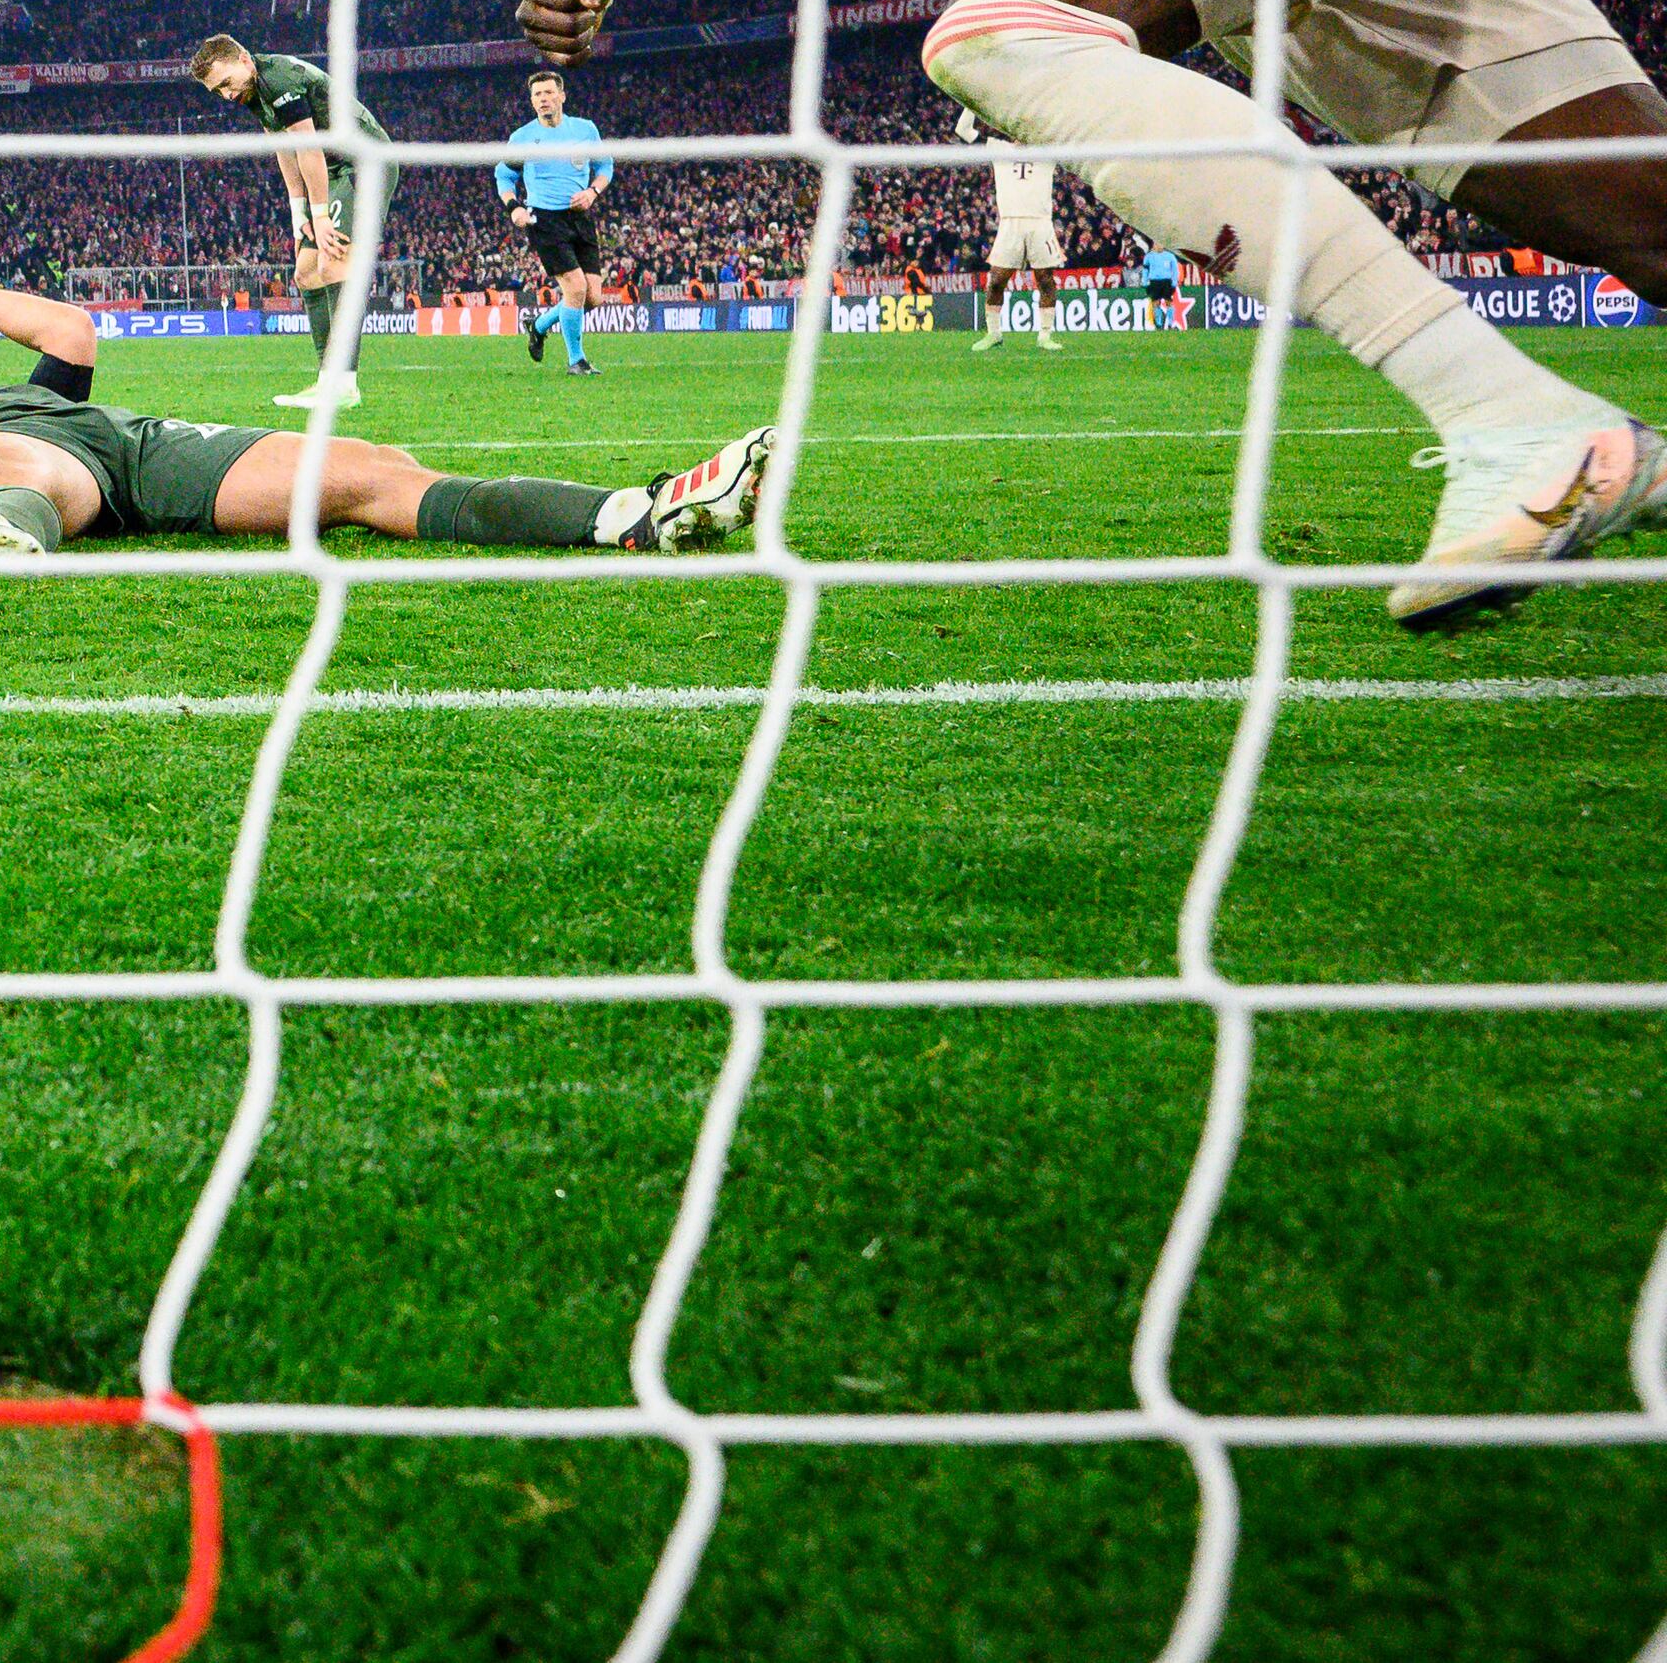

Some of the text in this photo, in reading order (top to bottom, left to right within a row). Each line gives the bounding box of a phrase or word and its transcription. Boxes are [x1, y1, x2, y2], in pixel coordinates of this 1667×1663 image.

[329, 200, 343, 228] 2
[831, 294, 934, 333] bet365
[1459, 289, 1540, 318] AGUE
[1596, 295, 1635, 308] PEPSI
[130, 314, 206, 334] PS5
[266, 314, 312, 333] #FOOT
[362, 311, 416, 334] stercard
[583, 305, 635, 332] RWAYS
